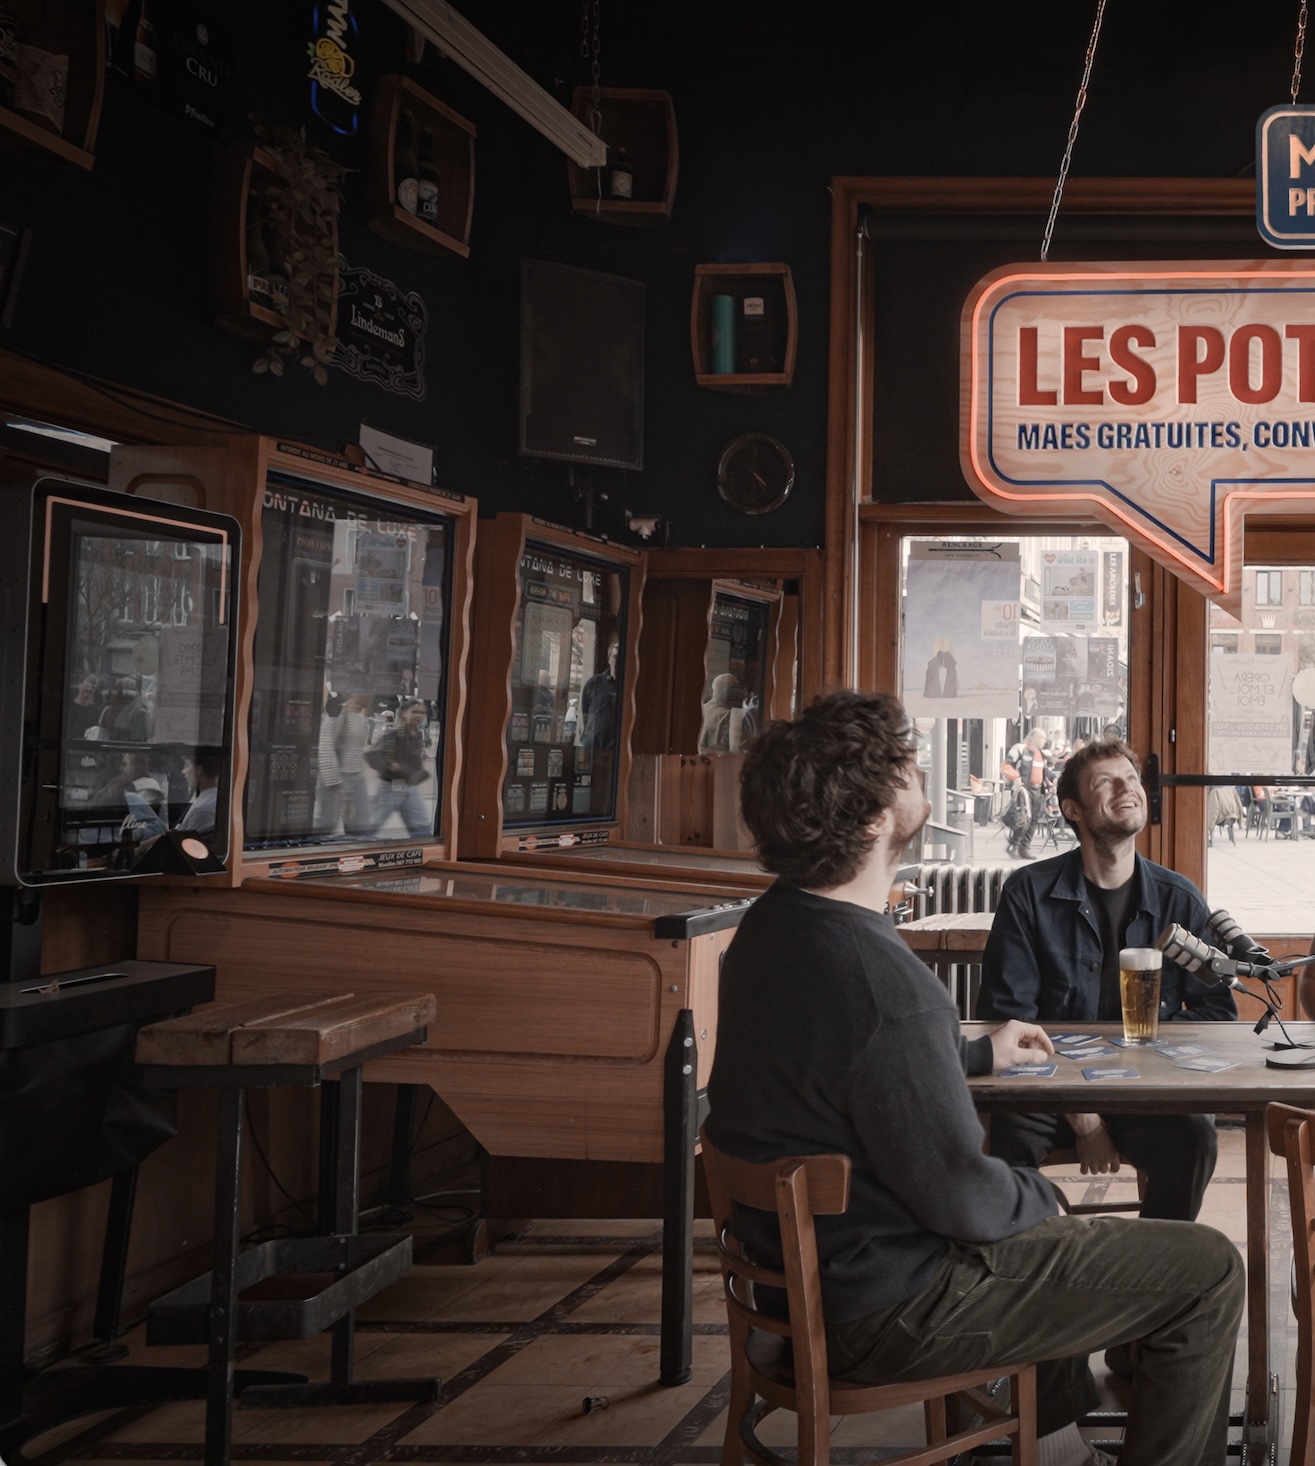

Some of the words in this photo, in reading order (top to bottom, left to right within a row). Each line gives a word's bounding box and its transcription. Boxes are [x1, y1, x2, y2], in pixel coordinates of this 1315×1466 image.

[327, 0, 348, 49] MA
[186, 57, 218, 87] CRU
[306, 57, 362, 106] Radler
[1017, 323, 1158, 407] LES
[1017, 421, 1092, 450] MAES
[1096, 421, 1250, 452] GRATUITES,
[263, 490, 336, 523] ONTANA
[378, 853, 396, 861] JEUX
